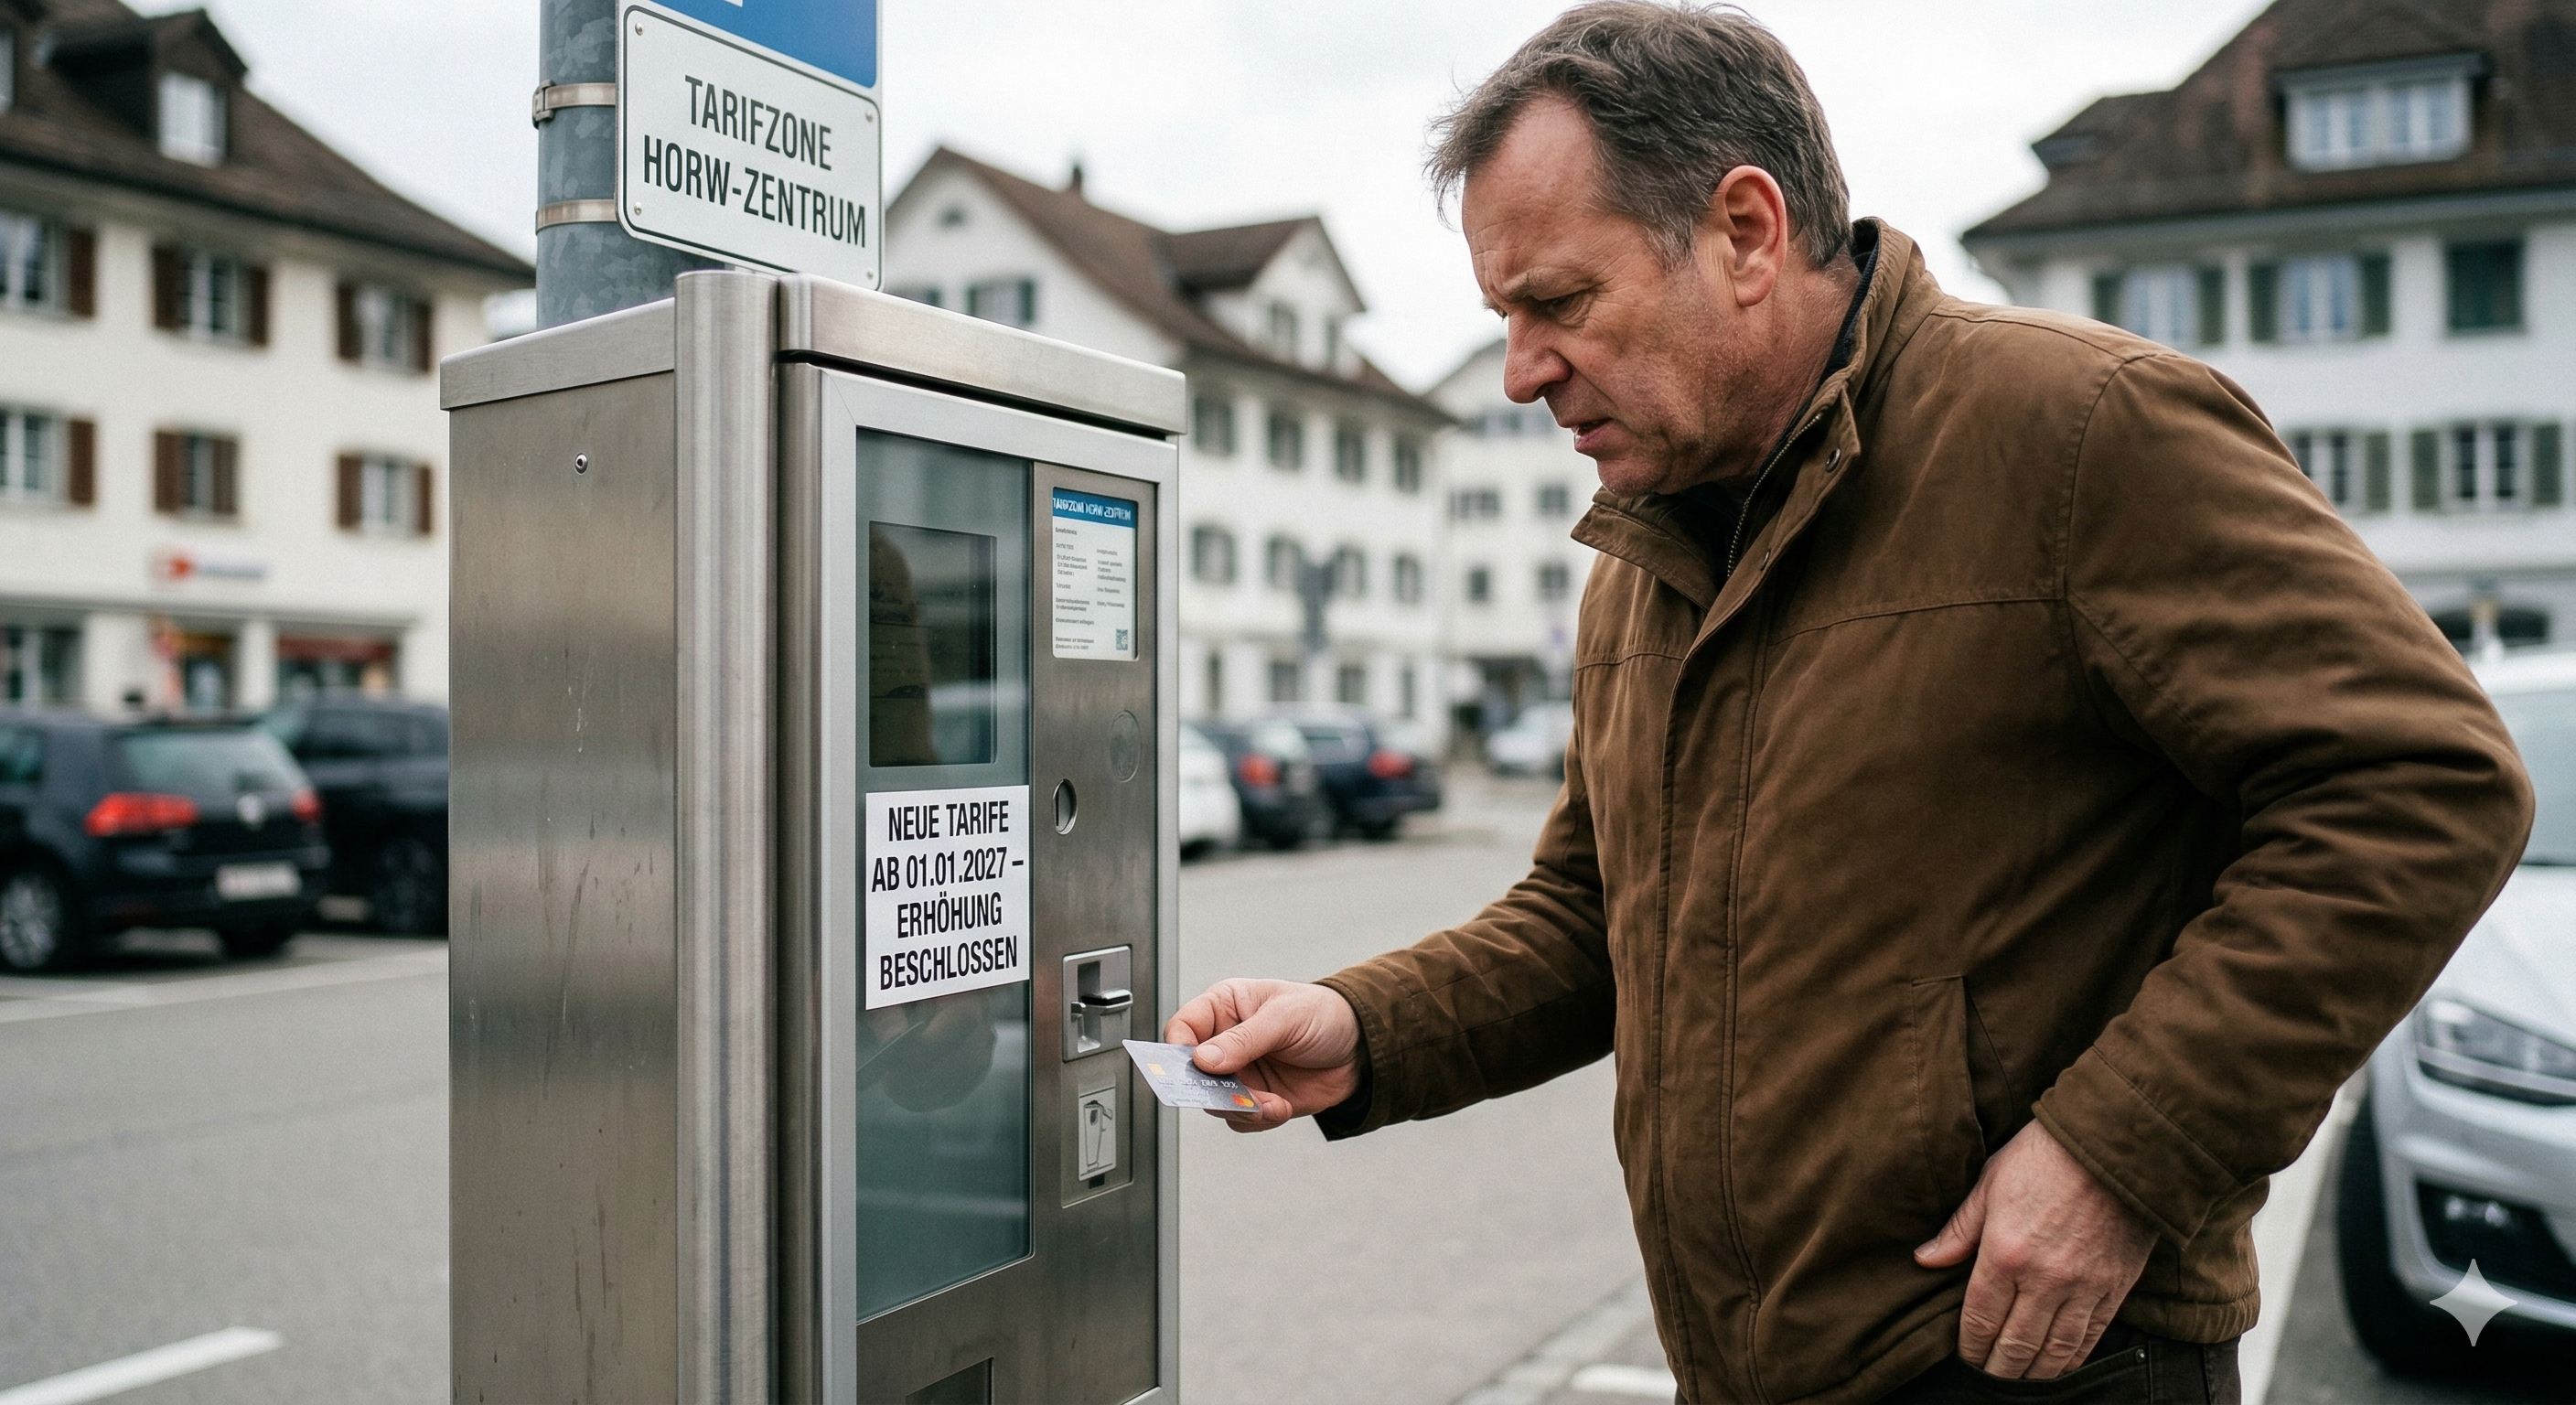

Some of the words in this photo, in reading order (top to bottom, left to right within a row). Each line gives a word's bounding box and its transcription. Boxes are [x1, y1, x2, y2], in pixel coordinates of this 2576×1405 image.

[685, 75, 831, 170] TARIFZONE
[644, 134, 865, 248] HORW-ZENTRUM
[888, 805, 939, 842] NEUE
[946, 800, 1009, 837] TARIFE
[872, 856, 900, 893] AB
[906, 846, 1007, 889] 01.01.2027
[897, 891, 1002, 939] ERHÖHUNG
[881, 935, 1018, 991] BESCHLOSSEN
